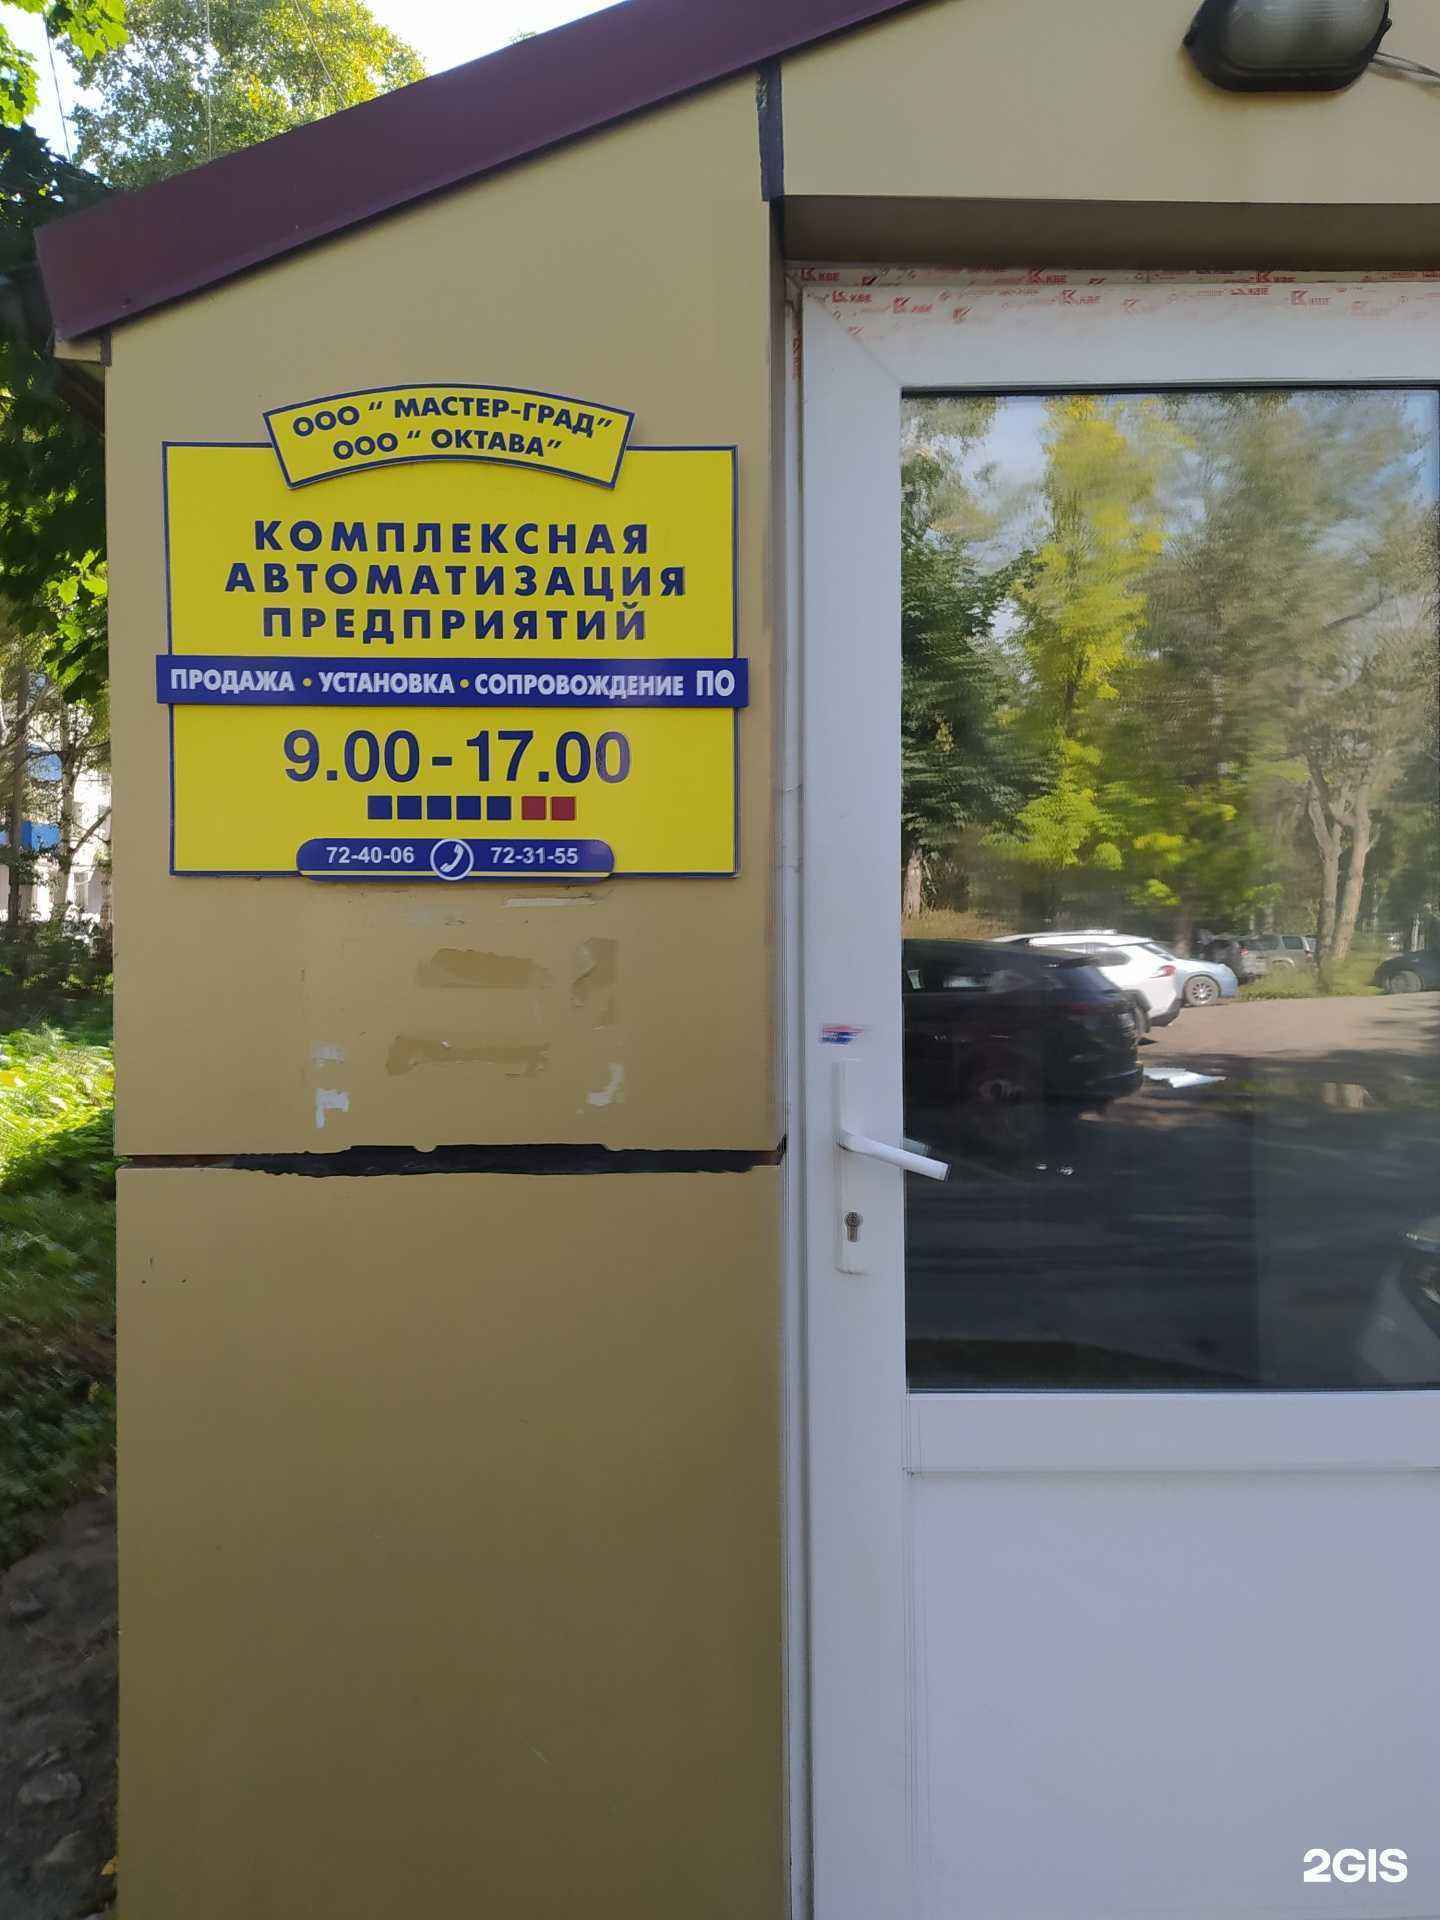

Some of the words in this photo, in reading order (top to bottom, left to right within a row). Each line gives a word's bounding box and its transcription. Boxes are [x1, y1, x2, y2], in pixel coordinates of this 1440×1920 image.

[293, 406, 360, 437] ООО
[333, 433, 398, 460] ООО
[254, 520, 648, 555] КОМПЛЕКСНАЯ
[225, 562, 686, 602] АВТОМАТИЗАЦИЯ
[263, 602, 646, 644] ПРЕДПРИЯТИЙ
[170, 668, 295, 694] ПРОДАЖА
[318, 671, 455, 694] УСТАНОВКА
[474, 673, 684, 699] СОПРОВОЖДЕНИЕ
[696, 669, 735, 697] ПО
[326, 846, 415, 865] 72-40-06
[490, 847, 579, 865] 72-31-55
